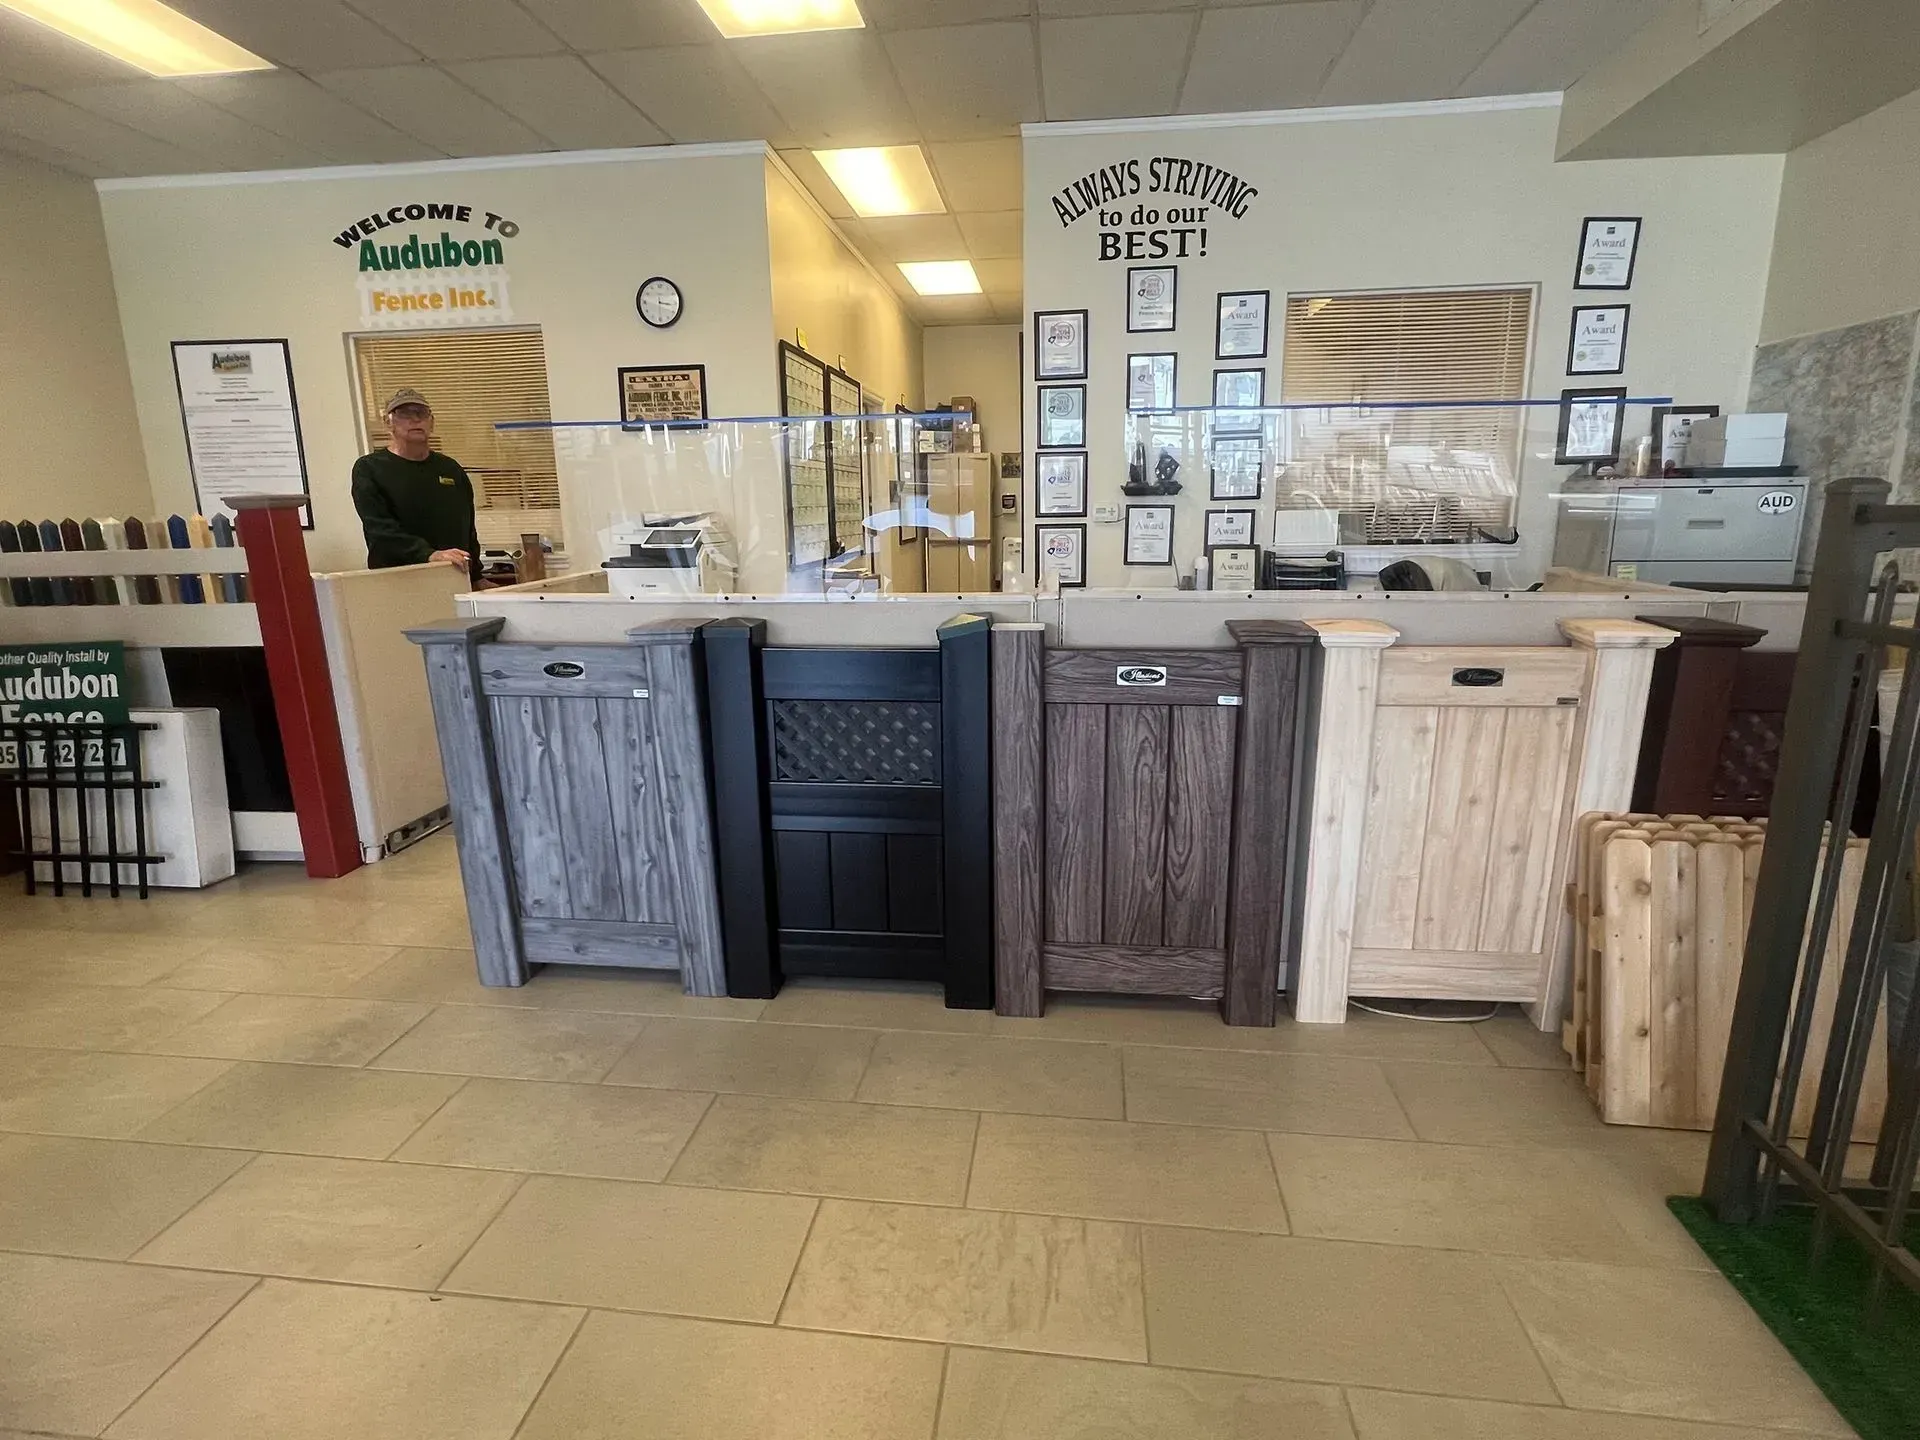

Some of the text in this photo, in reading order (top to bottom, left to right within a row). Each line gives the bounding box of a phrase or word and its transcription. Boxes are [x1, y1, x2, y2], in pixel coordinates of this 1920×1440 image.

[1051, 157, 1259, 228] ALWAYS STRIVING
[1099, 204, 1209, 226] to do our
[333, 204, 520, 249] WELCOME TO
[1098, 228, 1208, 261] BEST!
[1592, 238, 1627, 248] Award
[359, 232, 504, 272] Audubon
[372, 287, 496, 312] Fence Inc.
[1228, 309, 1258, 319] Award
[1582, 324, 1616, 335] Award
[1759, 496, 1794, 508] AUD
[1135, 521, 1164, 530] Award
[1214, 527, 1244, 536] Award
[1220, 561, 1249, 571] Award
[27, 651, 63, 666] Quality
[66, 649, 95, 663] Install
[98, 649, 109, 664] by
